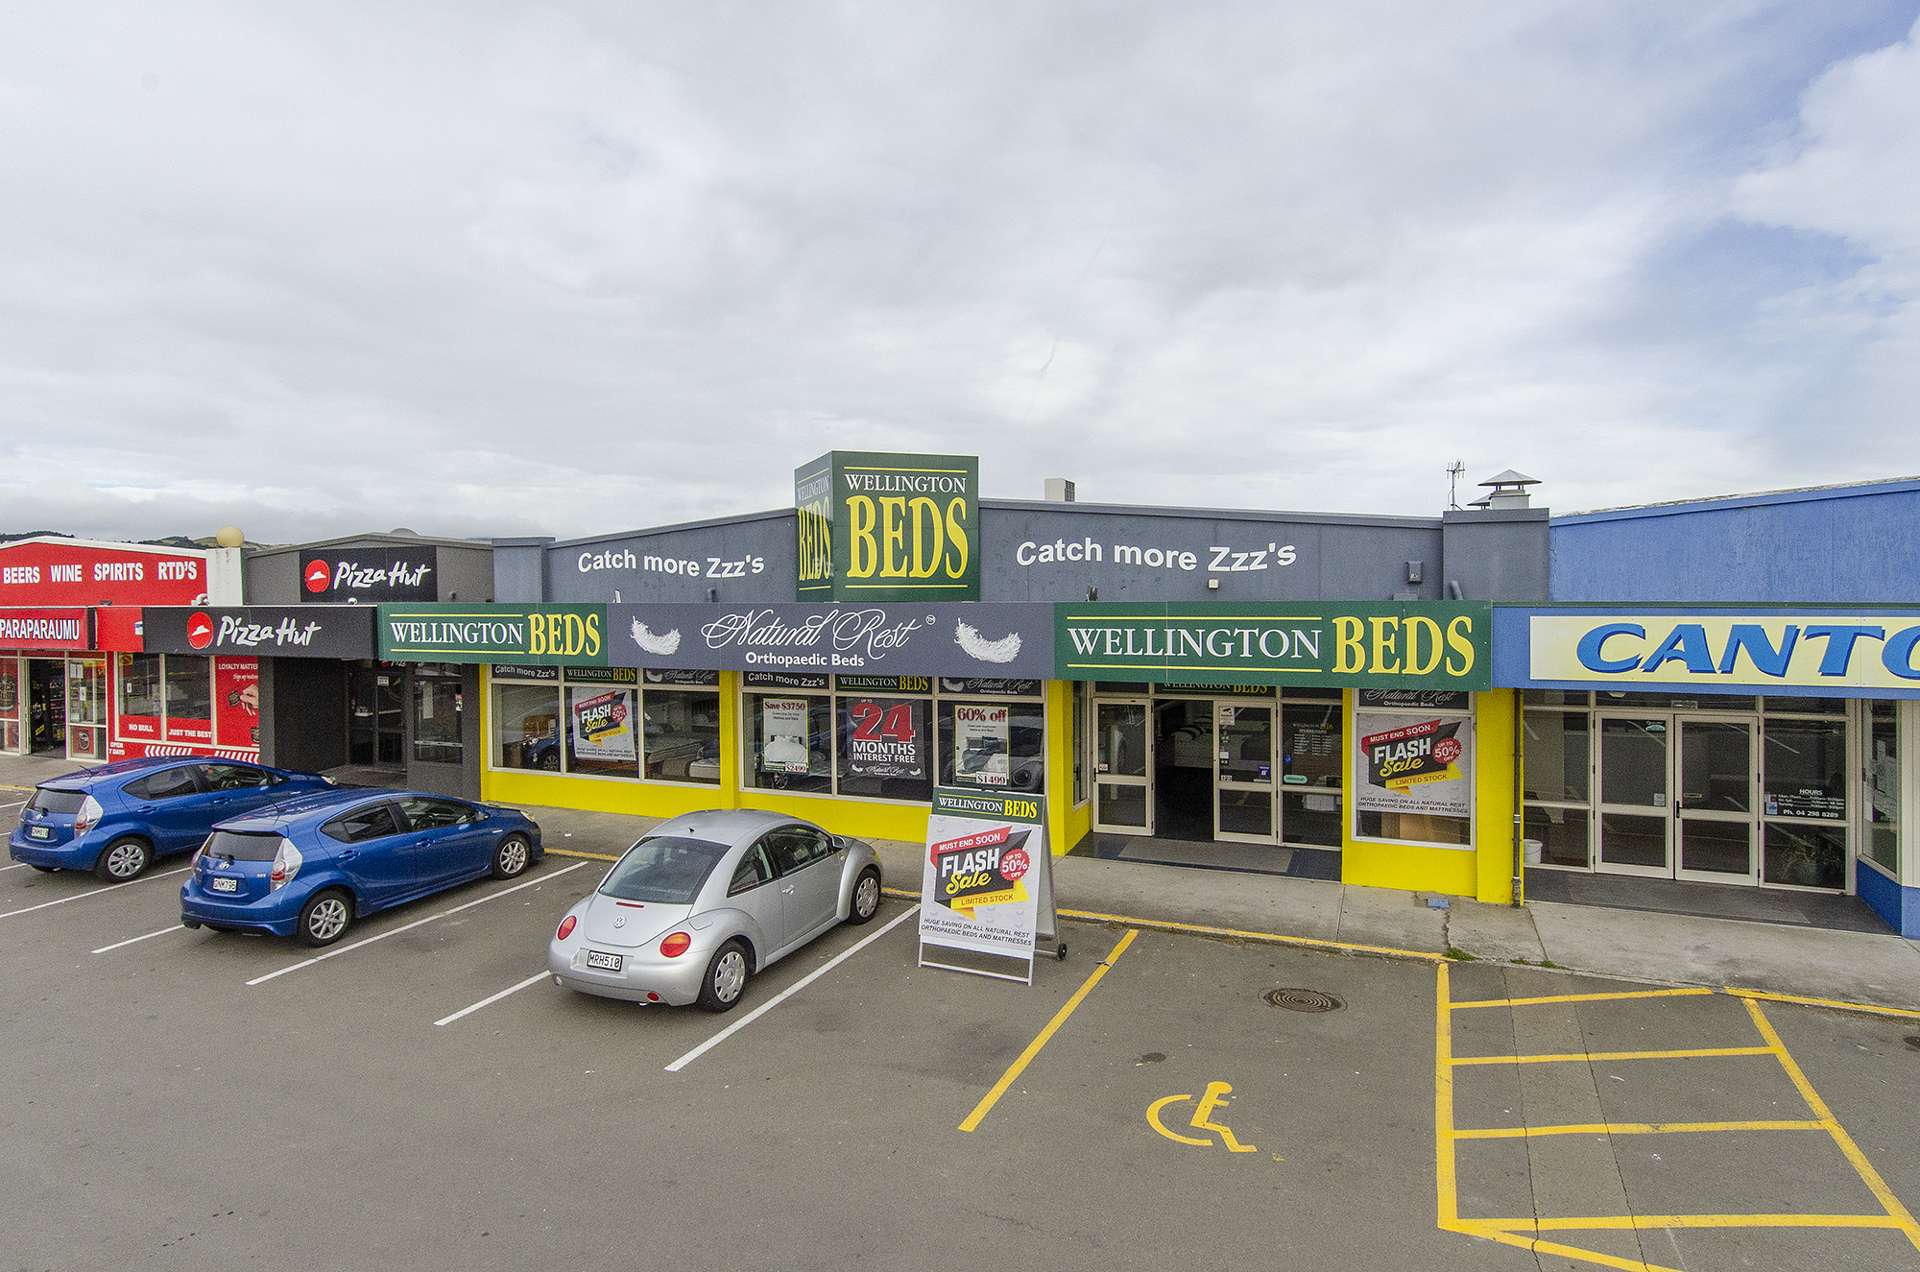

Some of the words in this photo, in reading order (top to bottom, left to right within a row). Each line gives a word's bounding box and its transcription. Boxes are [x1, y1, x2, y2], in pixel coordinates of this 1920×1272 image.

[844, 474, 966, 494] WELLINGTON
[799, 496, 831, 581] BEDS
[846, 494, 969, 580] BEDS
[578, 549, 637, 573] Catch
[644, 555, 700, 577] more
[706, 555, 765, 578] Zzz's
[1016, 537, 1102, 567] Catch
[1113, 543, 1197, 570] more
[1208, 543, 1298, 572] Zzz's
[3, 566, 41, 584] BEERS
[51, 565, 83, 582] WINE
[94, 563, 144, 581] SPIRITS
[158, 561, 198, 580] RTD'S
[333, 561, 387, 589] Pizza
[388, 561, 431, 587] Hut
[0, 618, 80, 640] PARAPARAUMU
[216, 616, 274, 646] Pizza
[276, 616, 322, 646] Hut
[390, 622, 523, 645] WELLINGTON
[528, 612, 602, 657] BEDS
[700, 608, 838, 648] Natural
[833, 608, 923, 660] Rest
[1067, 627, 1322, 660] WELLINGTON
[1331, 615, 1476, 676] BEDS
[745, 652, 828, 667] Orthopaedic
[831, 653, 865, 668] Beds
[495, 665, 515, 674] Catch
[516, 668, 536, 677] more
[536, 669, 556, 678] Zzz's
[567, 669, 612, 679] WELLINGTON
[613, 667, 636, 682] BEDS
[748, 673, 773, 682] Catch
[776, 675, 799, 686] more
[801, 677, 825, 687] Zzz's
[840, 677, 898, 687] WELLINGTON
[899, 675, 929, 691] BEDS
[581, 704, 611, 724] FLASH
[765, 702, 781, 710] Save
[781, 702, 805, 711] $3750
[957, 708, 986, 721] 60%
[990, 709, 1007, 721] off
[139, 724, 154, 732] BULL
[169, 728, 184, 736] JUST
[585, 719, 608, 733] Sale
[852, 703, 916, 743] 24
[1370, 734, 1388, 742] MUST
[1406, 724, 1431, 736] SOON
[852, 741, 916, 755] MONTHS
[853, 753, 892, 762] INTEREST
[895, 755, 915, 763] FREE
[1374, 738, 1431, 765] FLASH
[1434, 746, 1460, 758] 50%
[1379, 757, 1425, 777] Sale
[977, 776, 1006, 784] $1499
[1395, 776, 1423, 785] LIMITED
[1424, 774, 1448, 782] STOCK
[938, 797, 1003, 813] WELLINGTON
[1004, 799, 1038, 819] BEDS
[939, 841, 958, 851] MUST
[959, 839, 974, 848] END
[975, 833, 1001, 846] SOON
[941, 848, 1000, 878] FLASH
[1001, 859, 1029, 873] 50%
[1005, 854, 1013, 862] UP
[945, 872, 992, 895] Sale
[960, 896, 988, 906] LIMITED
[989, 894, 1014, 903] STOCK
[921, 924, 961, 936] ORTHOPAEDIC
[961, 930, 978, 938] BEDS
[978, 932, 992, 940] AND
[992, 934, 1032, 946] MATTRESSES
[924, 918, 940, 927] HUGE
[941, 920, 963, 929] SAVING
[973, 924, 984, 932] ALL
[984, 926, 1012, 936] NATURAL
[1013, 931, 1030, 939] REST
